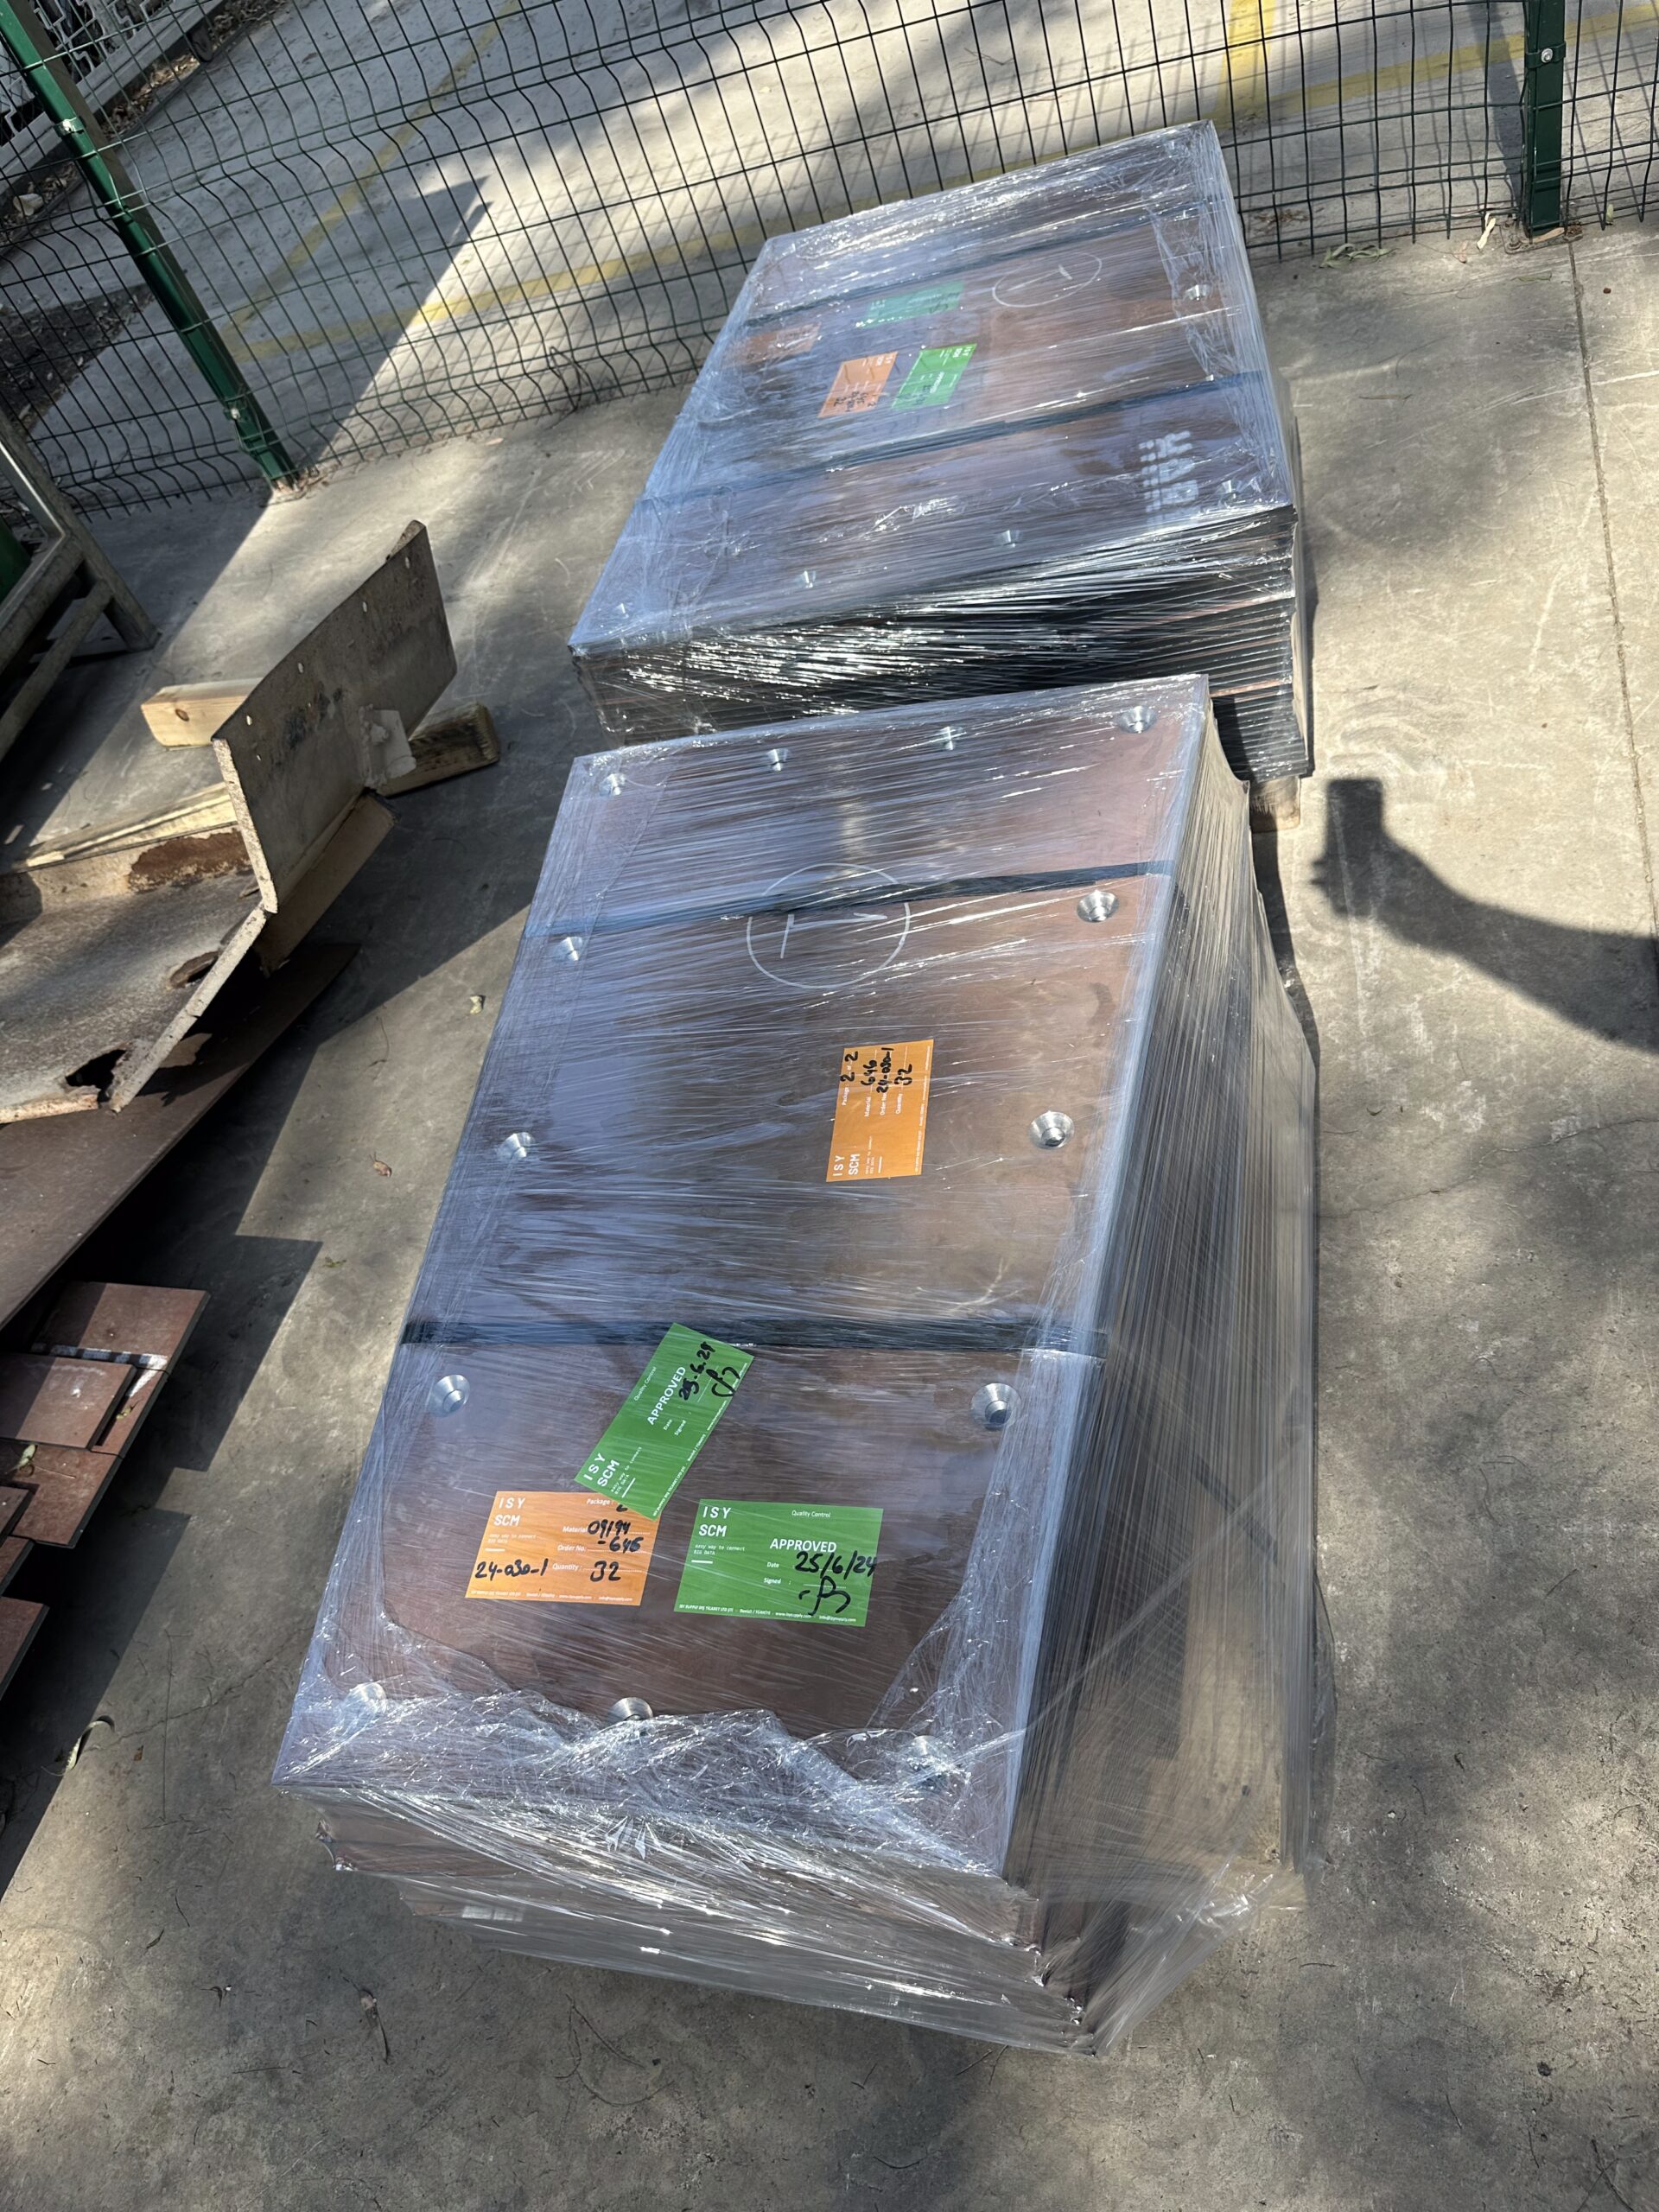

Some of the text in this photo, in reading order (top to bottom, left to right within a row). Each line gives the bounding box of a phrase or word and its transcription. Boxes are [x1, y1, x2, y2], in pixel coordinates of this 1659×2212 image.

[893, 1064, 912, 1086] 32
[848, 1154, 861, 1175] SCM
[633, 1366, 657, 1401] Quality Control
[647, 1366, 686, 1426] APPROVED
[663, 1419, 672, 1431] Date
[674, 1420, 687, 1436] Signed
[597, 1459, 620, 1487] SCM
[499, 1497, 525, 1509] ISY
[702, 1506, 732, 1519] ISY
[791, 1510, 810, 1518] Quality
[493, 1514, 521, 1527] SCM
[698, 1523, 728, 1537] SCM
[769, 1538, 837, 1553] APPROVED
[552, 1562, 579, 1572] Quantity
[589, 1560, 622, 1582] 32
[795, 1550, 878, 1580] 25/6/24
